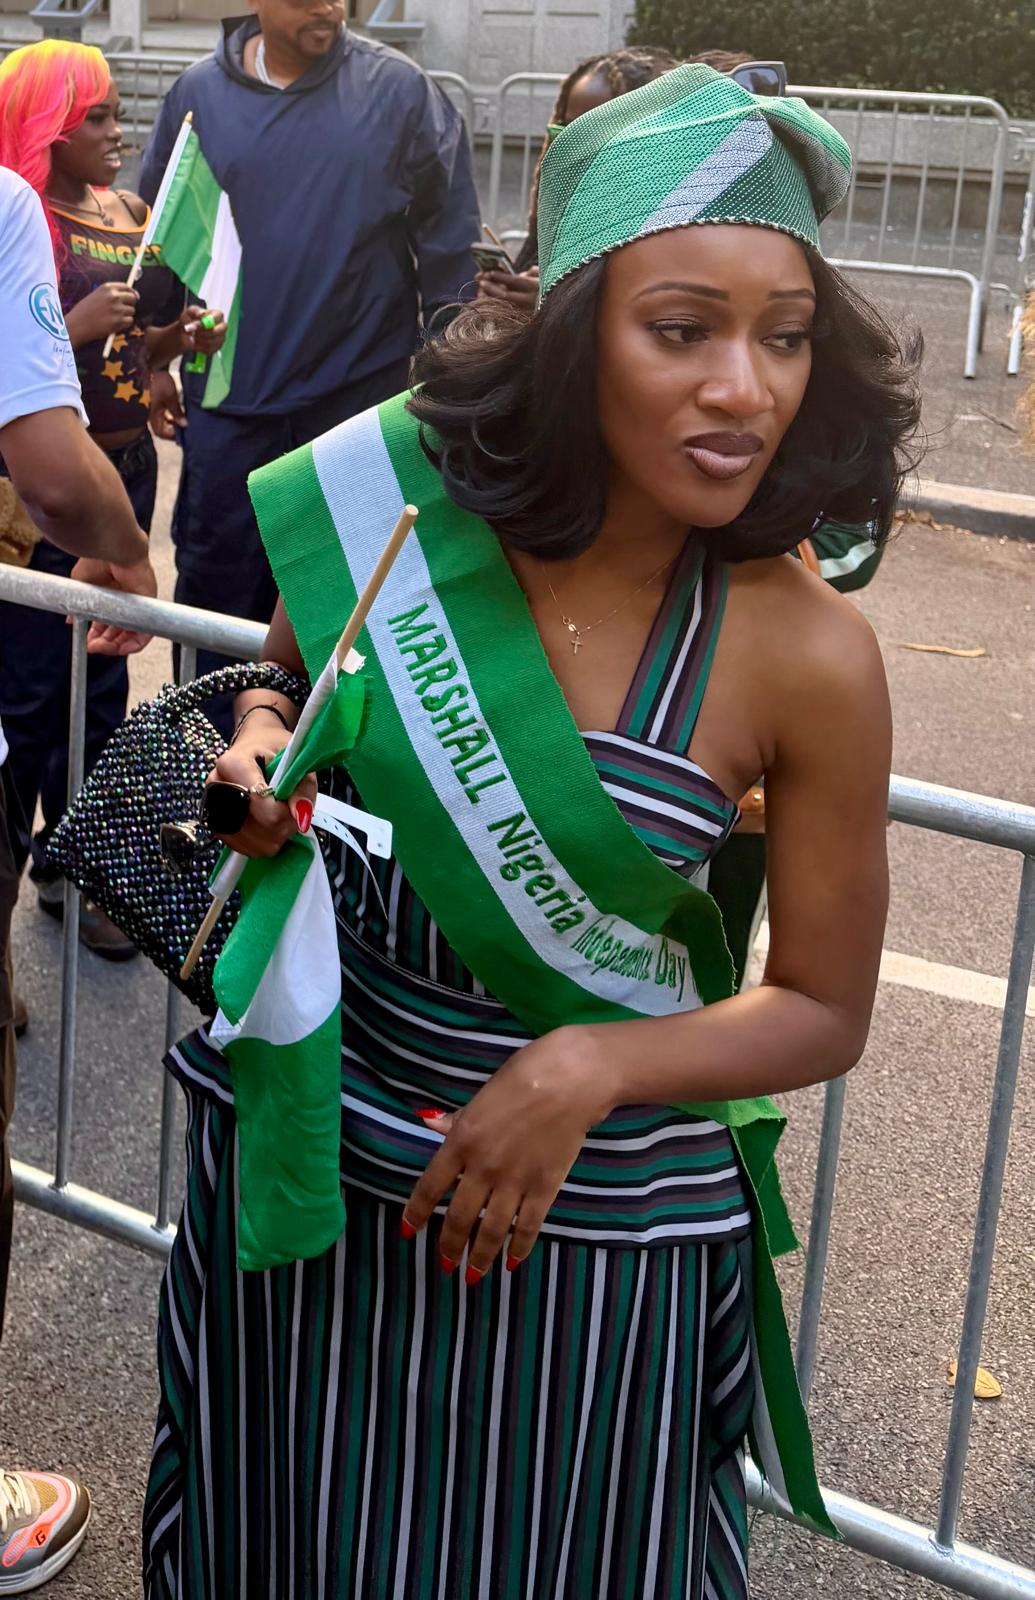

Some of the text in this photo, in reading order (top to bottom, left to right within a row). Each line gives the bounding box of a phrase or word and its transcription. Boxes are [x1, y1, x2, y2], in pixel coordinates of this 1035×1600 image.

[387, 602, 507, 804] MARSHALL
[486, 810, 587, 934] Nigeria
[655, 936, 686, 1003] Day
